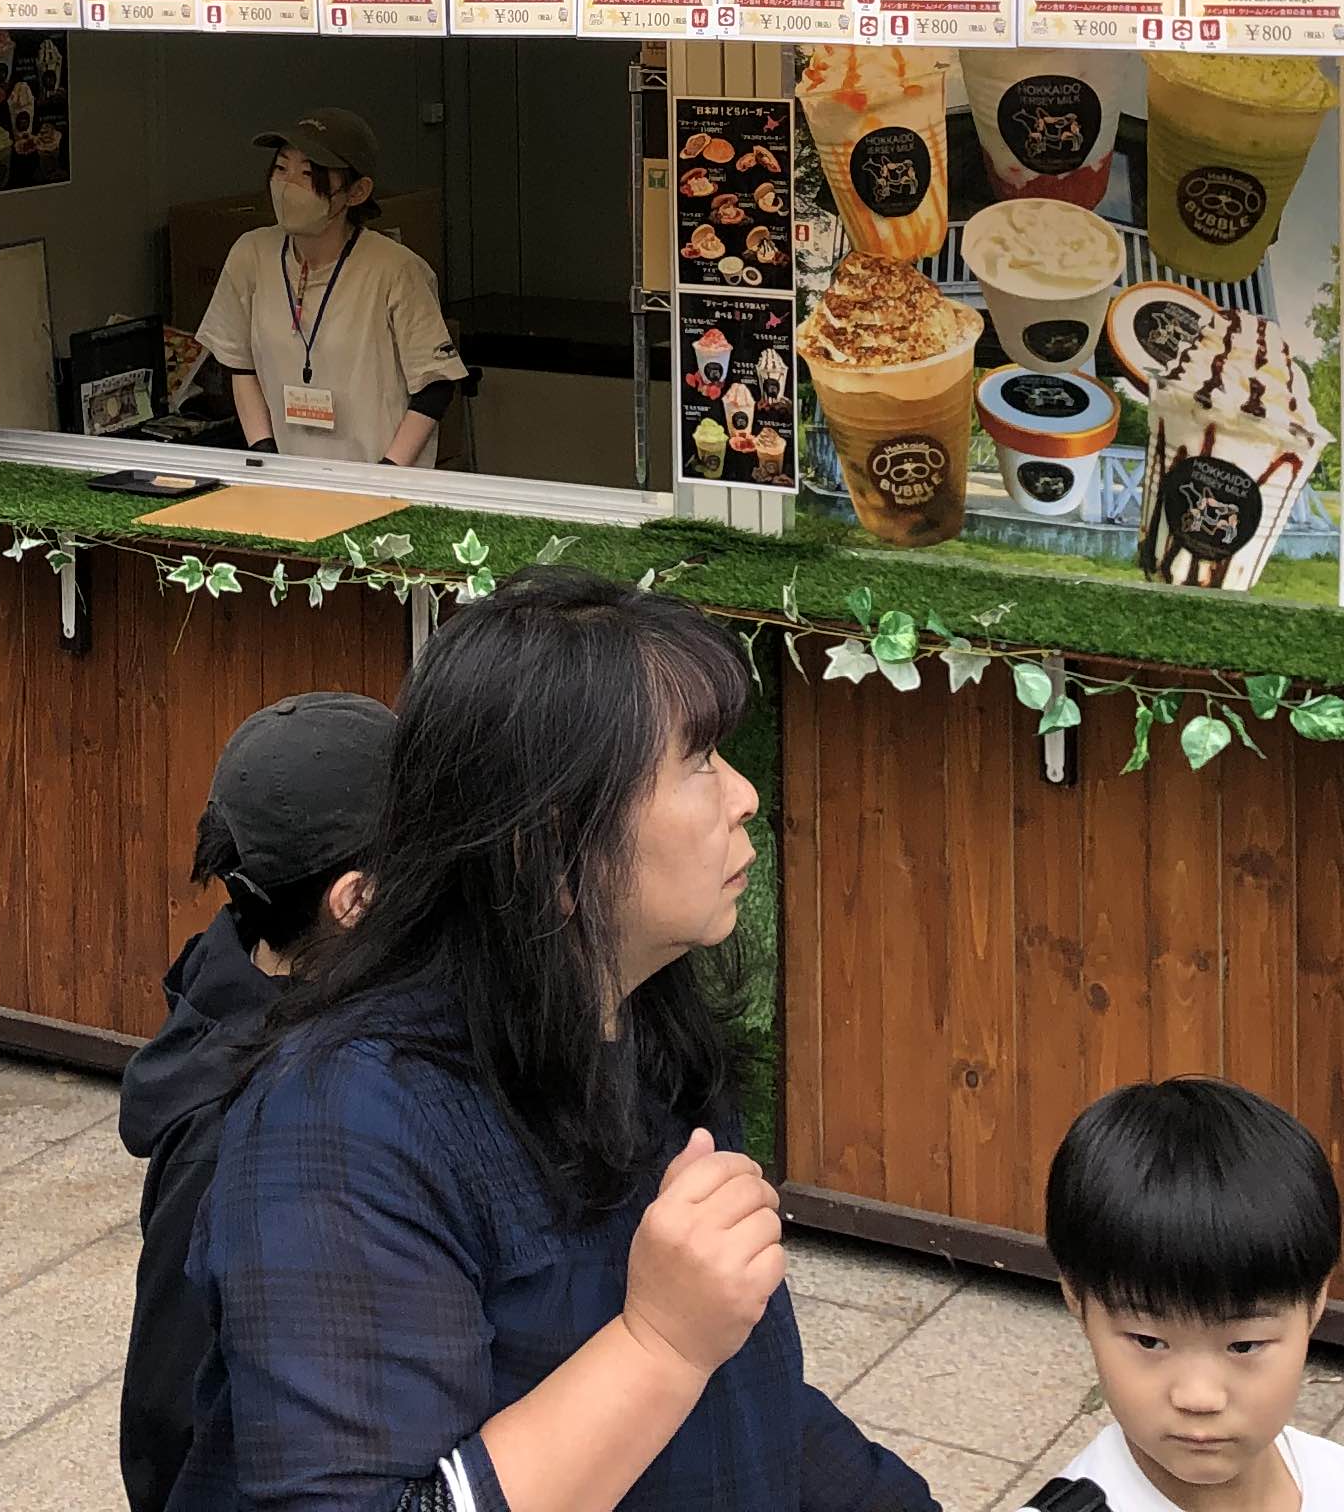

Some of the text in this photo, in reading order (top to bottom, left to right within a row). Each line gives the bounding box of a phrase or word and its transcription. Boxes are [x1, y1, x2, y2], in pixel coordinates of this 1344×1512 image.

[7, 3, 38, 17] ¥600
[121, 5, 154, 19] ¥600
[239, 7, 272, 21] ¥600
[363, 9, 398, 24] ¥600
[495, 8, 529, 24] ¥300
[619, 12, 671, 28] ¥1,100
[761, 14, 812, 31] ¥1,000
[917, 18, 958, 35] ¥800
[1074, 19, 1118, 36] ¥800
[1245, 24, 1292, 41] ¥800
